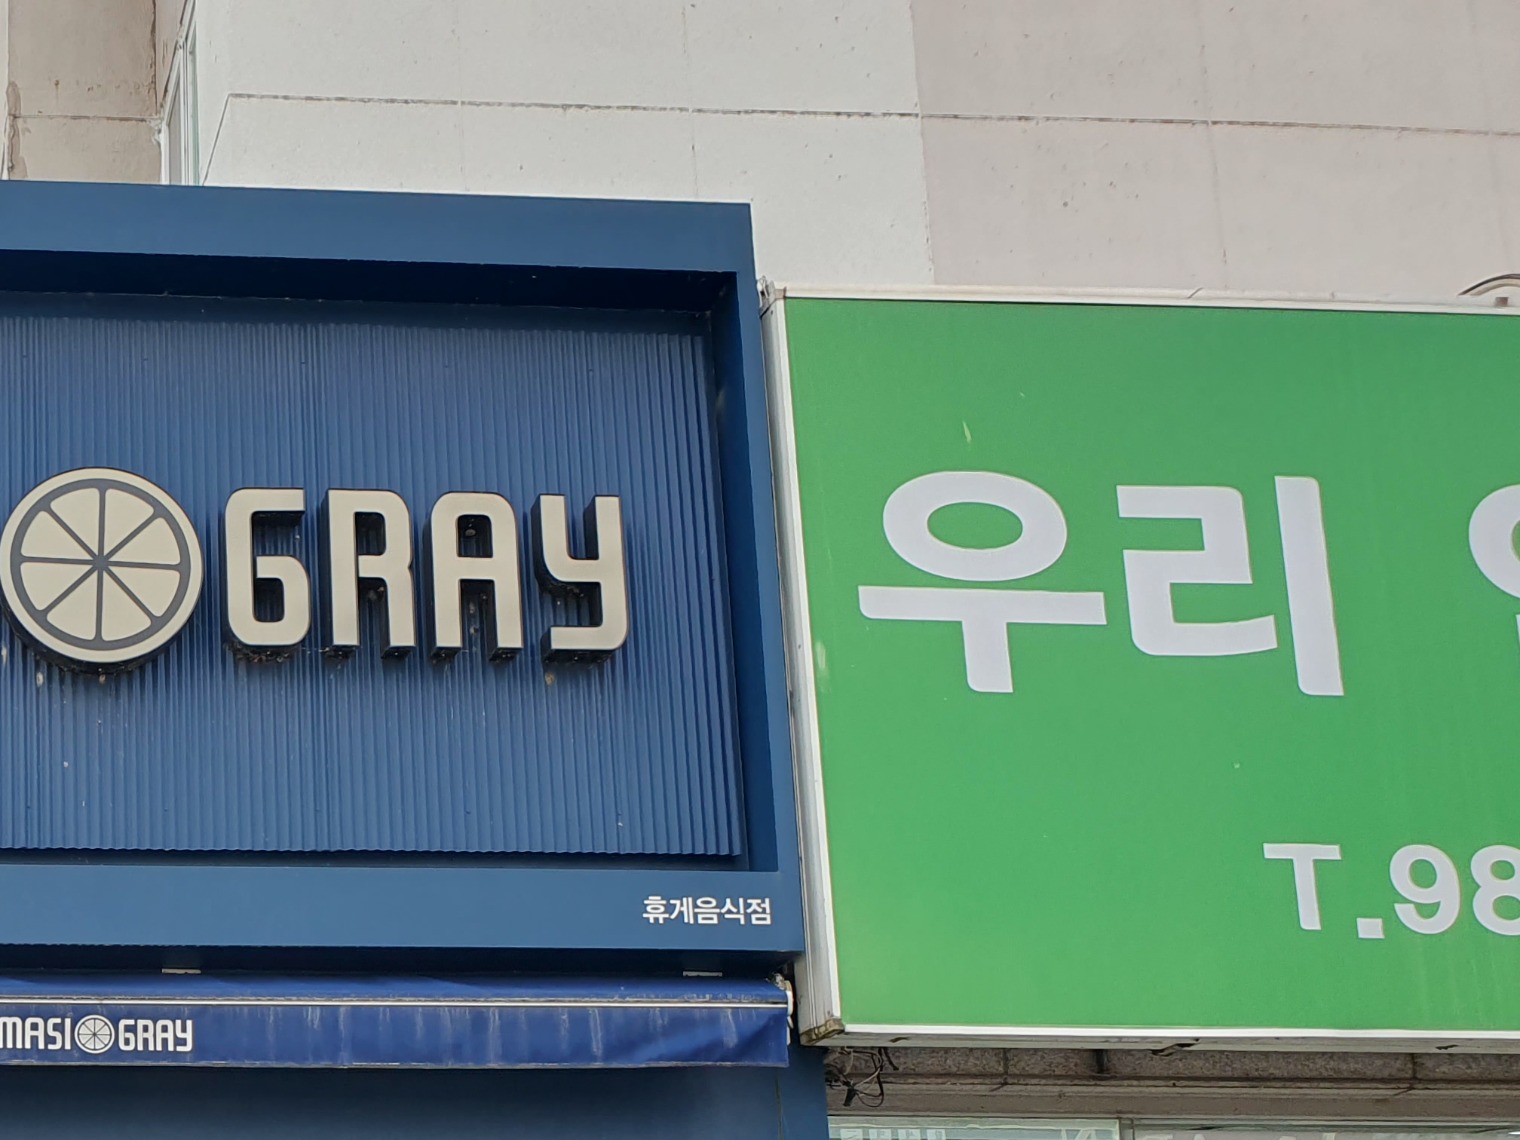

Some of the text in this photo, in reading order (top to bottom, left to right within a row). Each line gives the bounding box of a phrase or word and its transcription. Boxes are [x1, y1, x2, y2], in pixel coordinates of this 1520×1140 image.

[224, 485, 630, 656] GRAY
[857, 471, 1346, 697] 우리
[642, 895, 772, 925] 휴게음식점
[117, 1019, 193, 1052] GRAY
